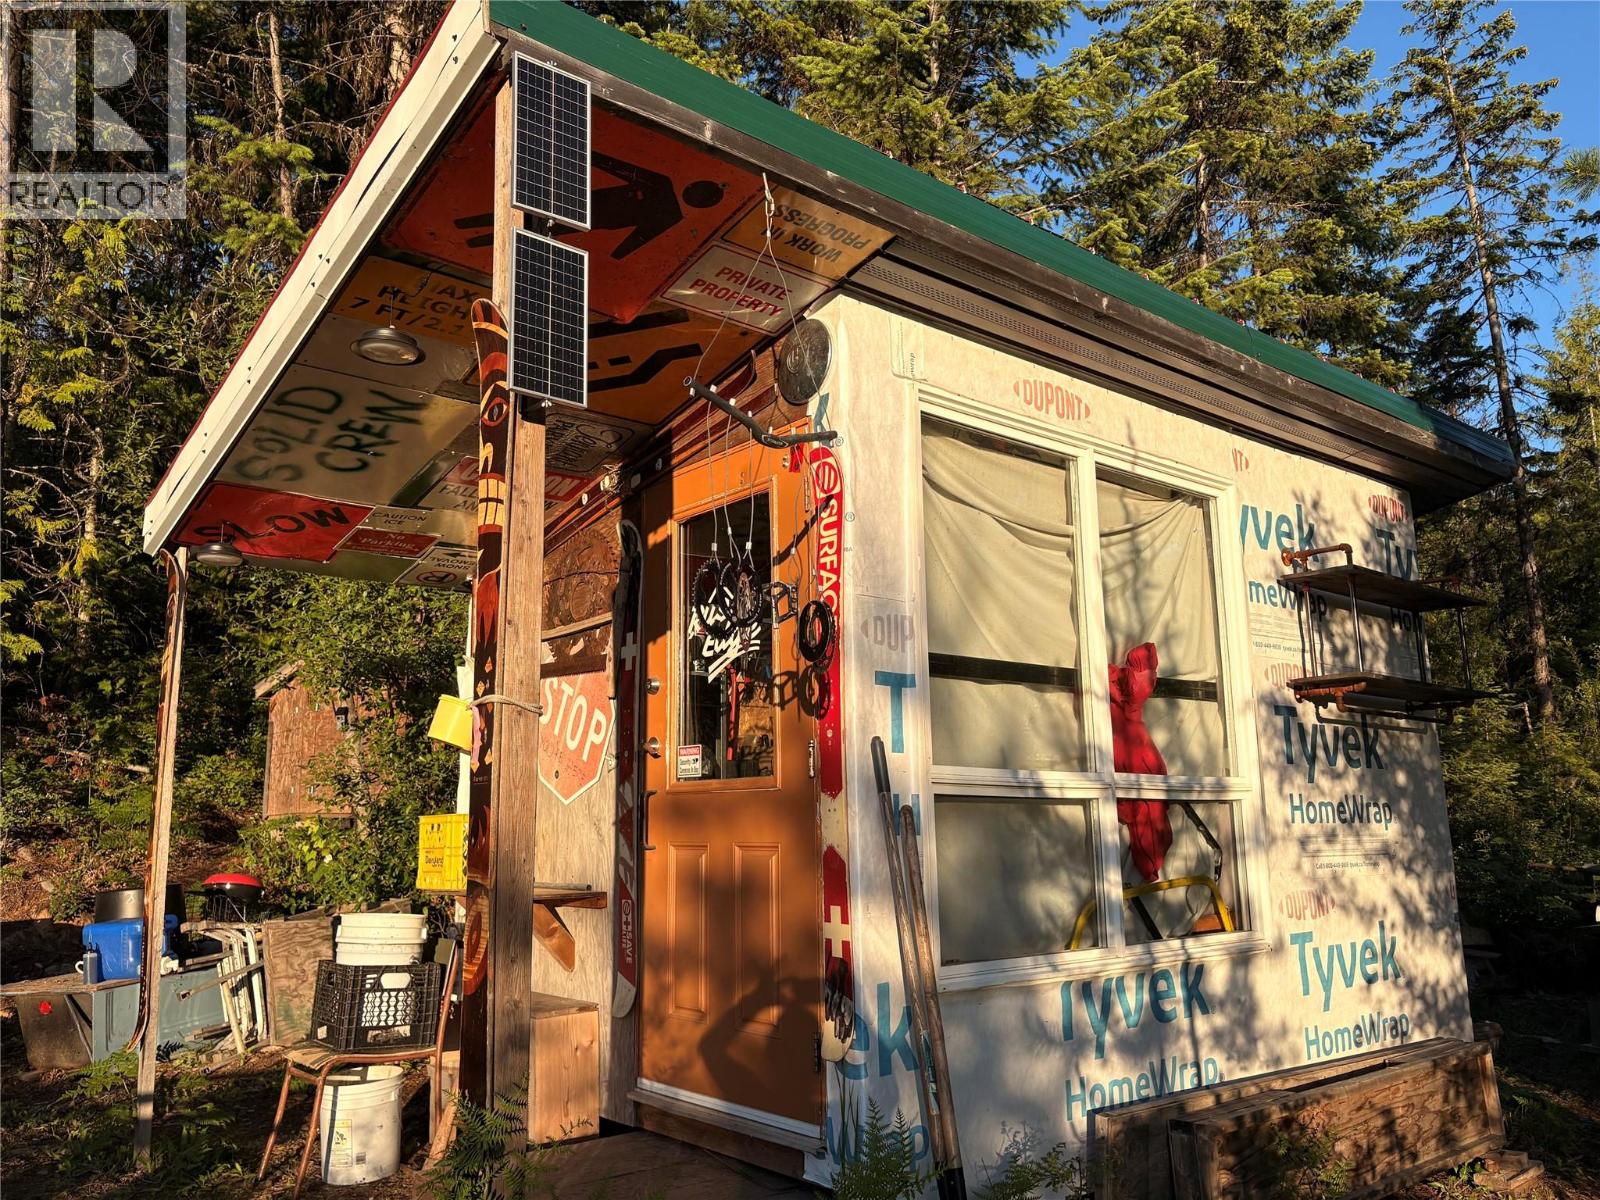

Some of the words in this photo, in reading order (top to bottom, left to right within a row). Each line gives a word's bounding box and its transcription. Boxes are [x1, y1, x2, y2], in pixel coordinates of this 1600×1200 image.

[761, 226, 784, 241] IN
[772, 204, 871, 250] PROGRESS
[784, 234, 844, 263] WORK
[688, 278, 785, 318] PROPERTY
[715, 266, 793, 302] PRIVATE
[1022, 379, 1083, 421] DUPONT
[194, 506, 350, 543] SLOW
[372, 512, 427, 522] CAUTION
[1372, 494, 1405, 523] DUPONT
[818, 498, 843, 612] SURFAC
[873, 614, 915, 653] DUP
[539, 677, 607, 763] STOP
[875, 670, 917, 754] T
[1273, 704, 1384, 784] Tyvek
[1289, 793, 1393, 830] HomeWrap
[1285, 887, 1330, 921] DUPONT
[625, 931, 633, 965] SAVE
[1289, 920, 1402, 1012] Tyvek
[1305, 1011, 1410, 1060] HomeWrap
[1065, 1055, 1219, 1122] HomeWrap
